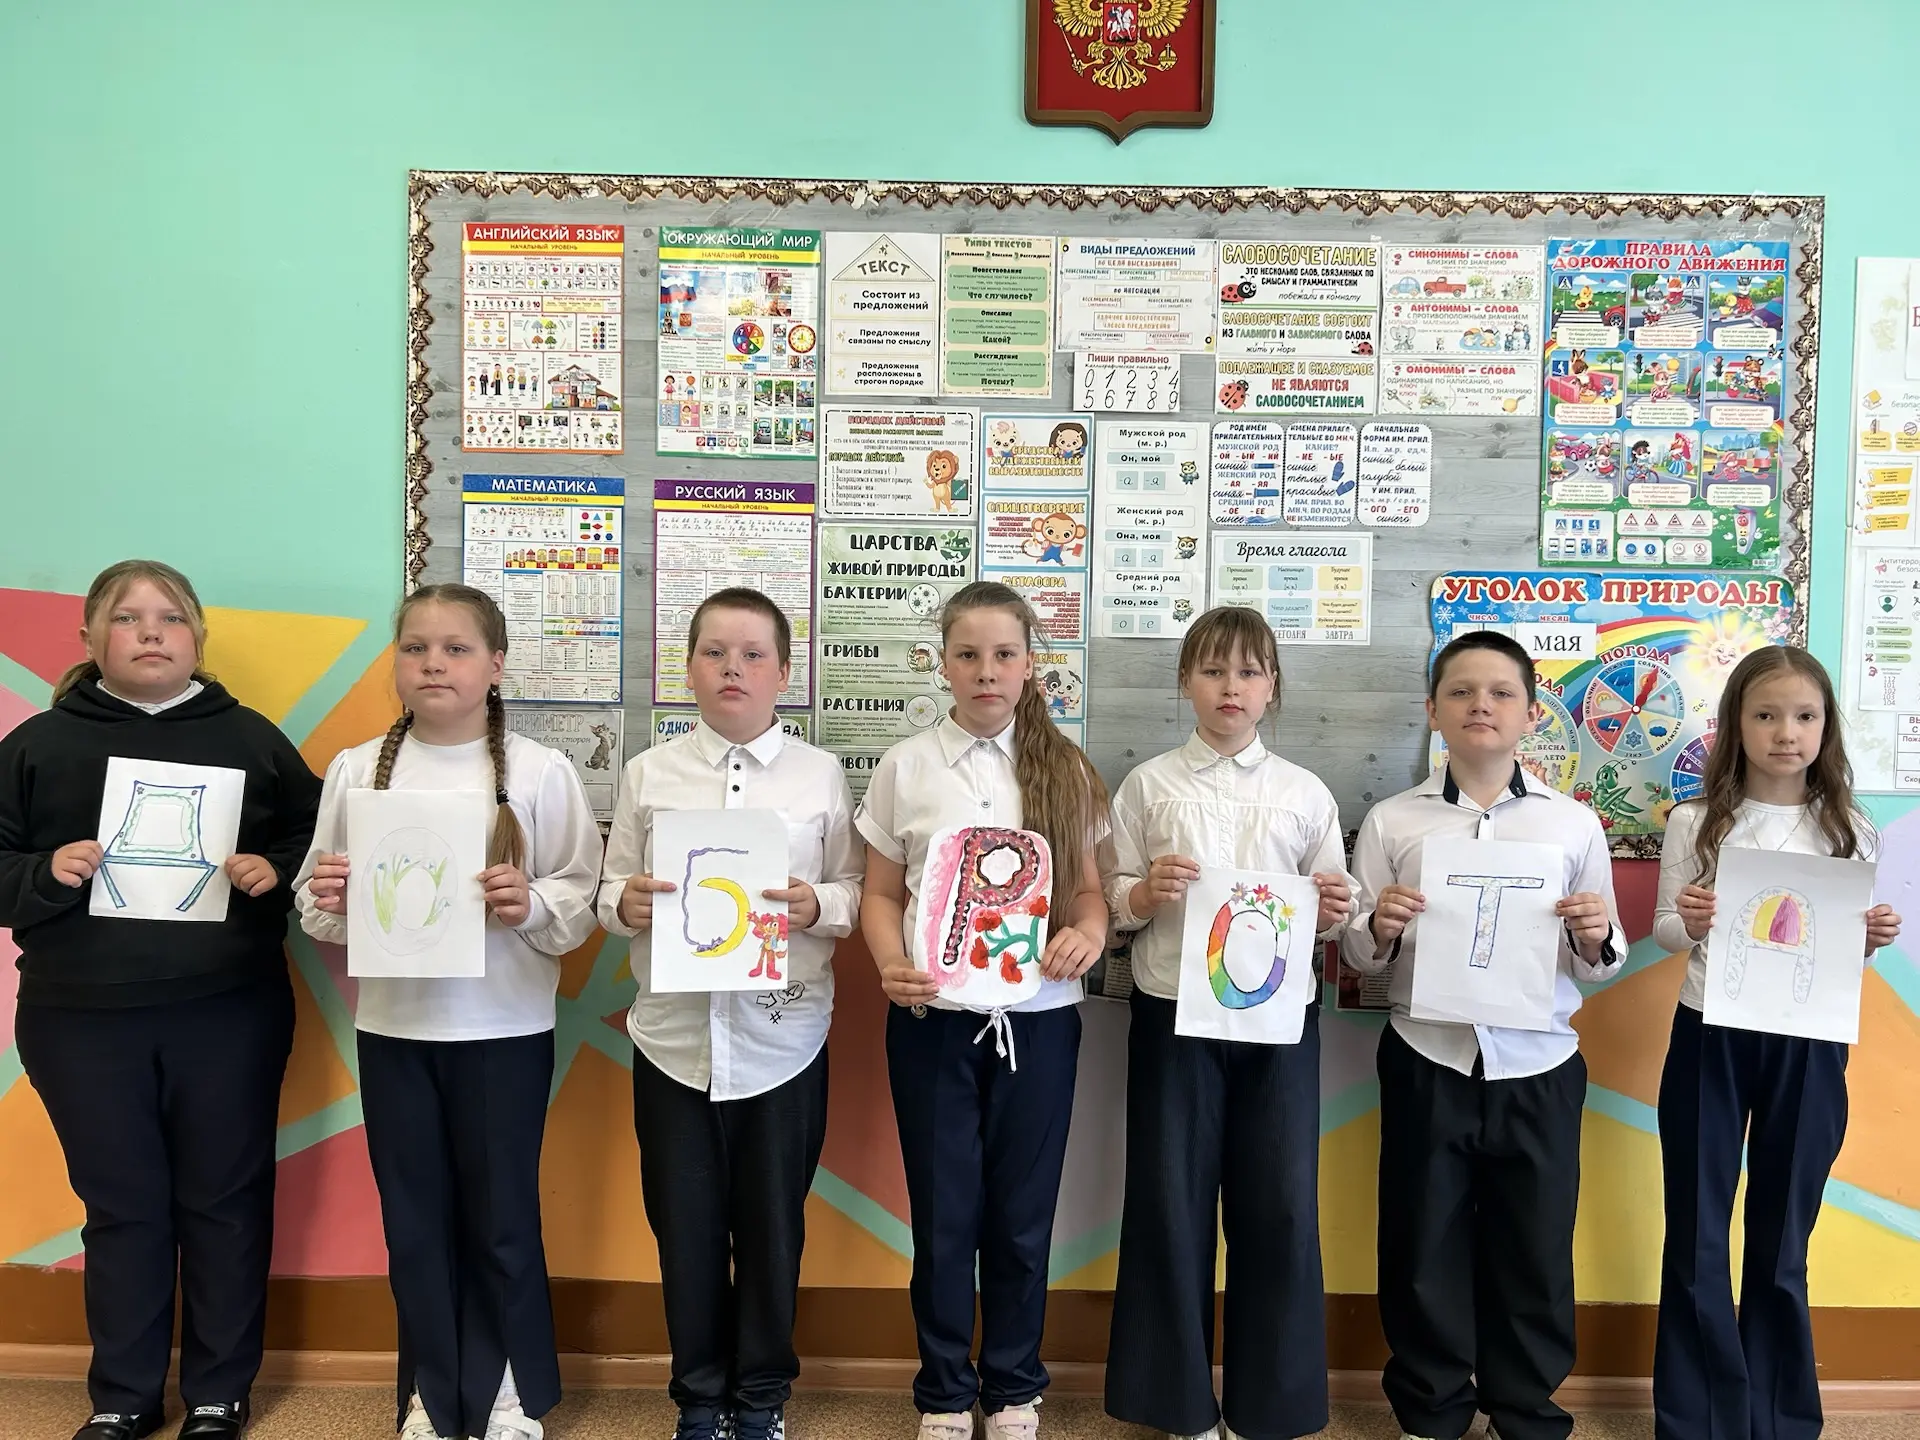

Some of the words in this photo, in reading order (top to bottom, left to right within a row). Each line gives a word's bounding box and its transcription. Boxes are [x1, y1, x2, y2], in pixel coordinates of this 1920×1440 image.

[473, 226, 569, 241] АНГЛИЙСКИЙ
[576, 229, 615, 241] ЯЗЫК
[668, 232, 775, 248] ОКРУЖАЮЩИЙ
[782, 236, 813, 247] МИР
[1080, 245, 1112, 255] ВИДЫ
[1115, 245, 1196, 256] ПРЕДЛОЖЕНИЙ
[1222, 244, 1377, 266] СЛОВОСОЧЕТАНИЕ
[1408, 250, 1469, 259] СИНОНИМЫ
[1626, 243, 1712, 256] ПРАВИЛА
[858, 260, 910, 276] ТЕКСТ
[1552, 257, 1670, 270] ДОРОЖНОГО
[1677, 258, 1786, 272] ДВИЖЕНИЯ
[1260, 268, 1298, 276] НЕСКОЛЬКО
[1301, 269, 1320, 277] СЛОВ,
[1321, 269, 1363, 277] СВЯЗАННЫХ
[1365, 269, 1374, 277] ПО
[1299, 278, 1358, 286] ГРАММАТИЧЕСКИ
[862, 290, 906, 299] Состоит
[1326, 294, 1361, 302] комнату
[853, 301, 929, 311] предложений
[1411, 304, 1471, 313] АНТОНИМЫ
[1485, 305, 1519, 313] СЛОВА
[1222, 312, 1320, 326] СЛОВОСОЧЕТАНИЕ
[1323, 314, 1372, 327] СОСТОИТ
[860, 329, 920, 338] Предложения
[1222, 329, 1233, 338] ИЗ
[1236, 329, 1277, 339] ГЛАВНОГО
[1288, 330, 1342, 339] ЗАВИСИМОГО
[1345, 330, 1371, 340] СЛОВА
[1088, 354, 1115, 362] Пиши
[1118, 354, 1169, 364] правильно
[861, 363, 919, 371] Предложения
[1219, 361, 1295, 375] ПОДЛЕЖАЩЕЕ
[1308, 362, 1375, 375] СКАЗУЕМОЕ
[1406, 366, 1465, 374] ОМОНИМЫ
[1480, 367, 1516, 375] СЛОВА
[857, 371, 914, 379] расположены
[1085, 369, 1095, 388] 0
[1105, 369, 1116, 388] 1
[1126, 370, 1137, 388] 2
[1147, 370, 1158, 389] 3
[1168, 370, 1179, 389] 4
[889, 379, 924, 387] порядке
[1272, 378, 1285, 391] НЕ
[1290, 379, 1349, 391] ЯВЛЯЮТСЯ
[1083, 389, 1094, 408] 5
[1104, 389, 1115, 408] 6
[1126, 390, 1136, 409] 7
[1147, 391, 1158, 409] 8
[1168, 391, 1178, 410] 9
[1256, 394, 1364, 408] СЛОВОСОЧЕТАНИЕМ
[848, 416, 893, 425] ПОРЯДОК
[895, 415, 945, 426] ДЕЙСТВИЙ
[1120, 430, 1165, 438] Мужской
[829, 452, 862, 462] ПОРЯДОК
[1362, 455, 1394, 464] синий
[1215, 461, 1248, 470] синий
[1395, 459, 1427, 472] белый
[1361, 469, 1402, 486] голубой
[492, 479, 597, 493] МАТЕМАТИКА
[675, 485, 746, 499] РУССКИЙ
[754, 489, 795, 500] ЯЗЫК
[1286, 485, 1335, 497] красивые
[1213, 490, 1244, 498] синяя
[987, 502, 1085, 514] ОЛИЦЕТВОРЕНИЕ
[1218, 498, 1254, 506] СРЕДНИЙ
[1258, 499, 1274, 507] РОД
[1117, 507, 1162, 515] Женский
[1116, 532, 1138, 540] Она,
[850, 534, 938, 552] ЦАРСТВА
[1237, 541, 1285, 562] Время
[1288, 546, 1347, 557] глагола
[828, 560, 882, 575] ЖИВОЙ
[886, 563, 965, 578] ПРИРОДЫ
[1001, 576, 1067, 588] МЕТАФОРА
[824, 586, 907, 600] БАКТЕРИИ
[1444, 579, 1587, 602] УГОЛОК
[1602, 580, 1782, 607] ПРИРОДЫ
[1114, 598, 1136, 606] Оно,
[1325, 631, 1354, 640] ЗАВТРА
[1534, 635, 1582, 651] мая
[824, 644, 879, 658] ГРИБЫ
[1600, 645, 1670, 666] ПОГОДА
[823, 698, 904, 712] РАСТЕНИЯ
[1586, 682, 1597, 715] ОБЛАЧНО
[1675, 687, 1684, 711] ТУМАН
[1655, 721, 1682, 752] ПАСМУРНО
[1567, 759, 1577, 780] ИЮНЬ
[100, 780, 219, 913] Д
[360, 826, 459, 957] О
[942, 825, 1040, 967] Р
[1446, 874, 1545, 969] Т
[1206, 883, 1294, 1011] О
[1724, 885, 1816, 1004] А
